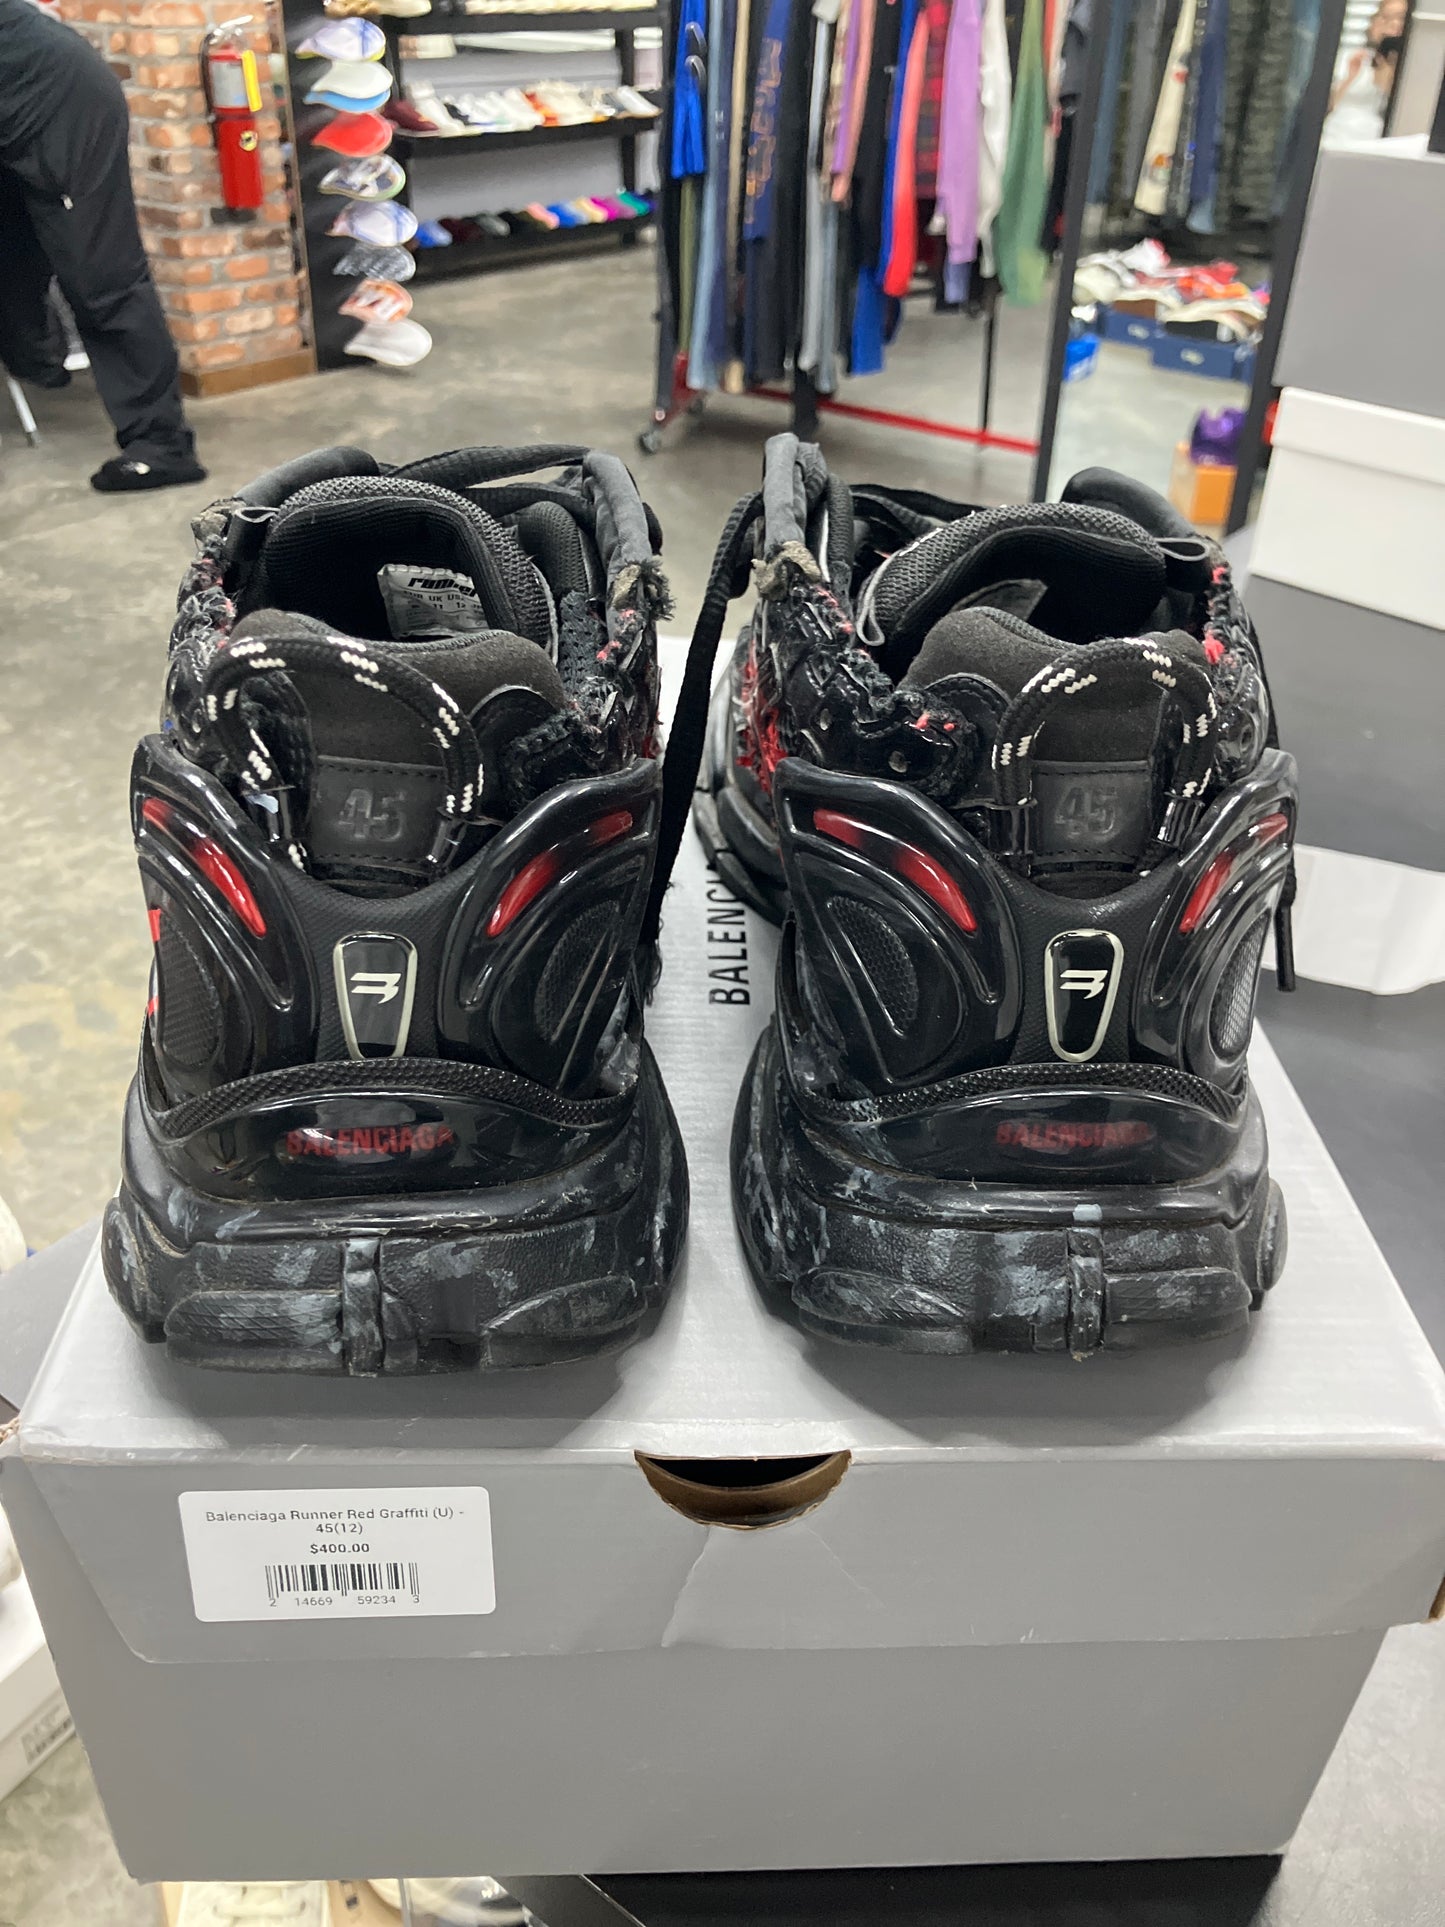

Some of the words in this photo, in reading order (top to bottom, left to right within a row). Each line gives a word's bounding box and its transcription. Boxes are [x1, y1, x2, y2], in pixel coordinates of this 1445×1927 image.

[706, 862, 751, 1006] BALENC
[205, 1510, 286, 1523] Balenciaga
[290, 1509, 344, 1521] Runner
[347, 1508, 375, 1520] Red
[379, 1506, 429, 1519] Graffiti
[432, 1506, 454, 1520] (U)
[315, 1522, 364, 1535] 45(12)
[310, 1542, 371, 1555] $400.00
[269, 1598, 278, 1608] 2
[294, 1596, 334, 1607] 14669
[356, 1594, 397, 1605] 59234
[412, 1594, 421, 1604] 3
